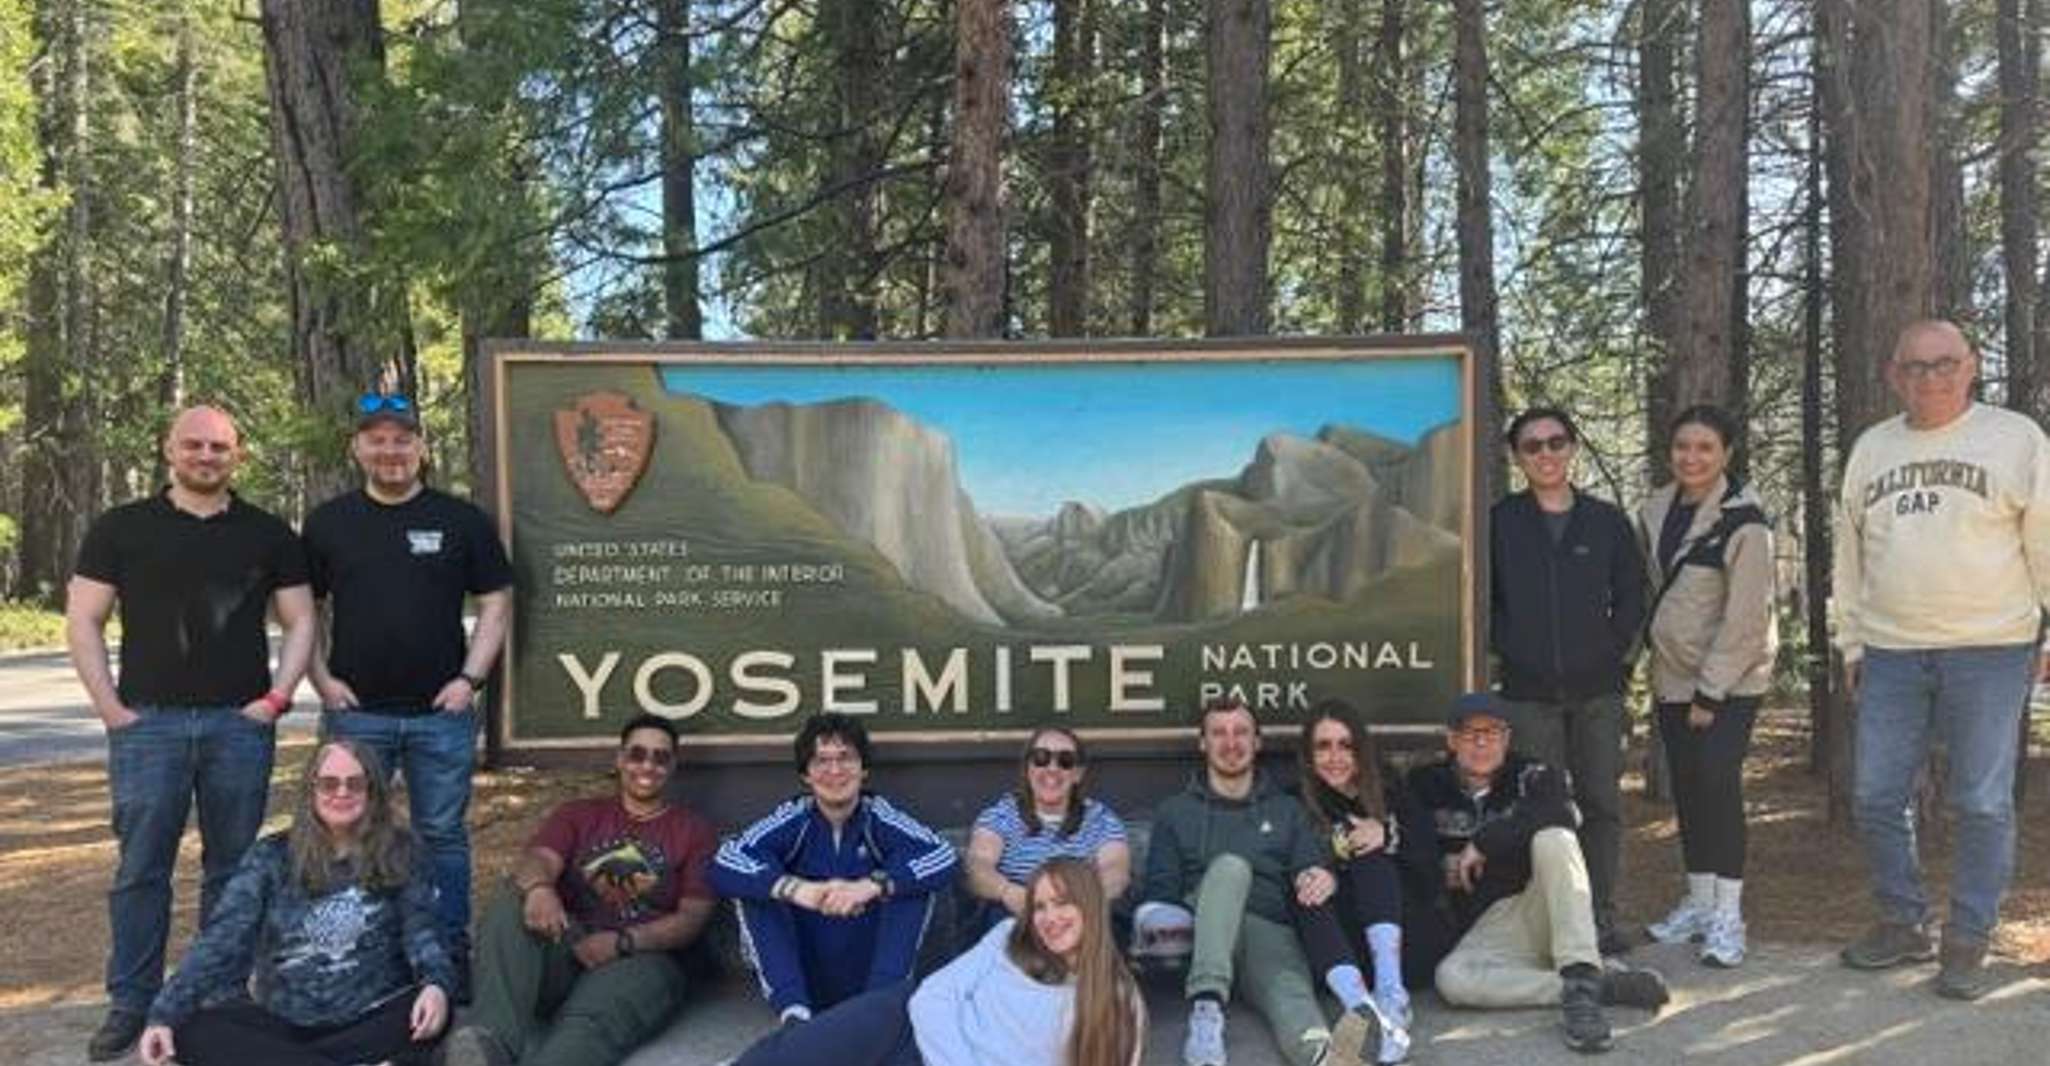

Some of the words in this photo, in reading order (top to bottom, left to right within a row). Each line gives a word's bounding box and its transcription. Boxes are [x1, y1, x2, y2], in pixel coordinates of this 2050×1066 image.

[1863, 459, 1987, 508] CALIFORNIA
[1896, 491, 1940, 515] GAP
[554, 542, 619, 557] UNITED
[626, 541, 688, 557] STATES
[553, 564, 671, 584] DEPARTMENT
[685, 565, 711, 583] OF
[719, 565, 752, 582] THE
[761, 564, 845, 583] INTERIOR
[556, 592, 645, 608] NATIONAL
[655, 591, 701, 607] PARK
[711, 589, 783, 607] SERVICE
[1202, 641, 1434, 671] NATIONAL
[558, 644, 1167, 720] YOSEMITE
[1200, 682, 1309, 709] PARK
